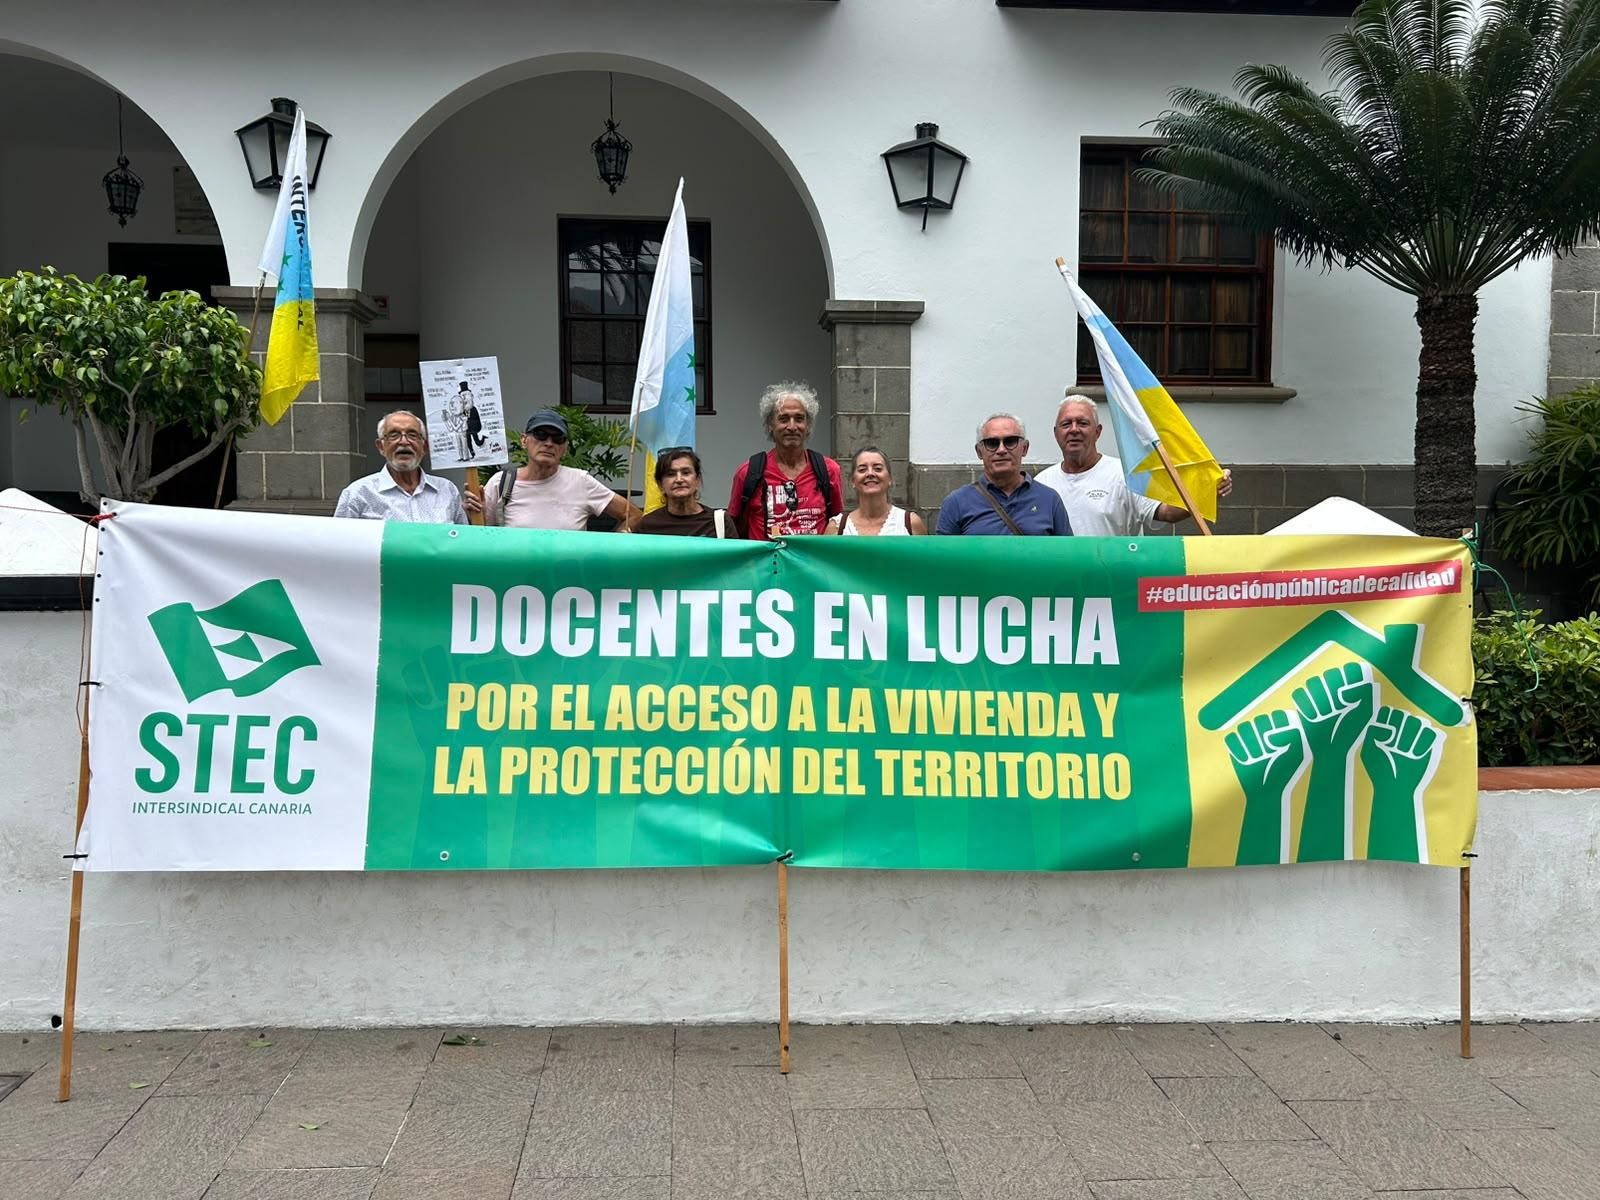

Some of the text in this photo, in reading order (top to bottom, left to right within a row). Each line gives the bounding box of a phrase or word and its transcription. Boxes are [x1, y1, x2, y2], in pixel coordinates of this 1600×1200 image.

[1146, 567, 1455, 604] #educaciónpúblicadecalidad
[451, 584, 1121, 665] DOCENTES EN LUCHA
[446, 683, 1120, 738] POR EL ACCESO A LA VIVIENDA Y
[135, 712, 318, 795] STEC
[433, 738, 1132, 800] LA PROTECCIÓN DEL TERRITORIO
[132, 802, 313, 815] INTERSINDICAL CANARIA
